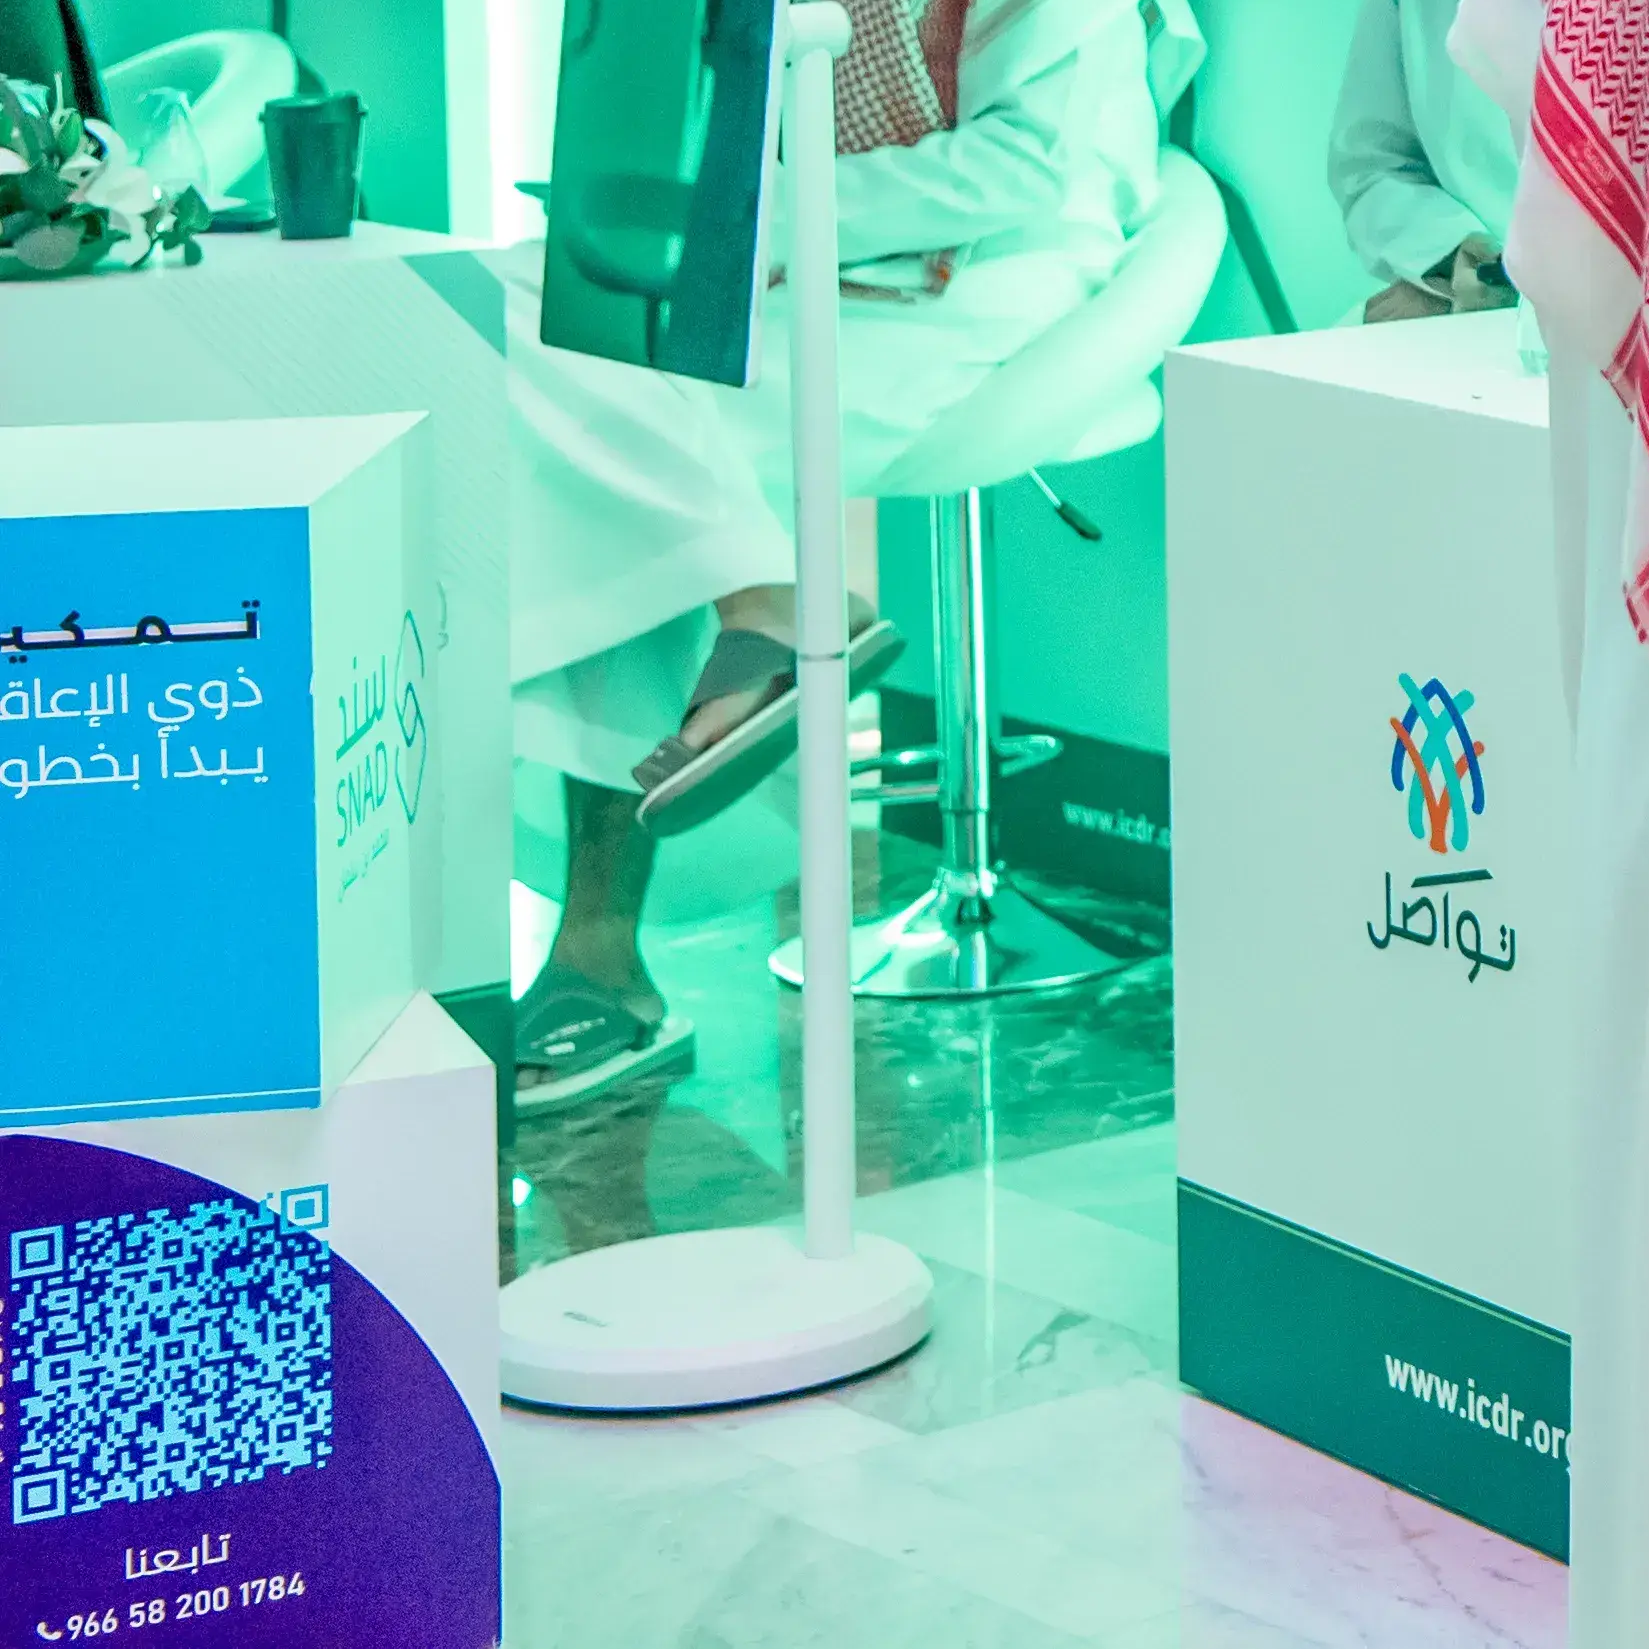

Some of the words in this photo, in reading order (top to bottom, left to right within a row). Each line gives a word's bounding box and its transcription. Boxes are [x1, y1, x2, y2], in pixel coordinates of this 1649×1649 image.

[0, 599, 261, 664] تمكي
[0, 673, 130, 729] الإعاق
[148, 666, 265, 733] ذوي
[0, 743, 141, 800] بخطو
[159, 723, 269, 788] يبدأ
[336, 740, 389, 848] SNAD
[1062, 801, 1171, 851] www.icdr.o
[1366, 868, 1517, 984] تواصل
[1385, 1354, 1573, 1478] www.icdr.or
[125, 1533, 232, 1580] تابعنا
[66, 1605, 118, 1641] 966
[128, 1600, 167, 1630] 58
[175, 1586, 230, 1621] 200
[238, 1571, 305, 1607] 1784
